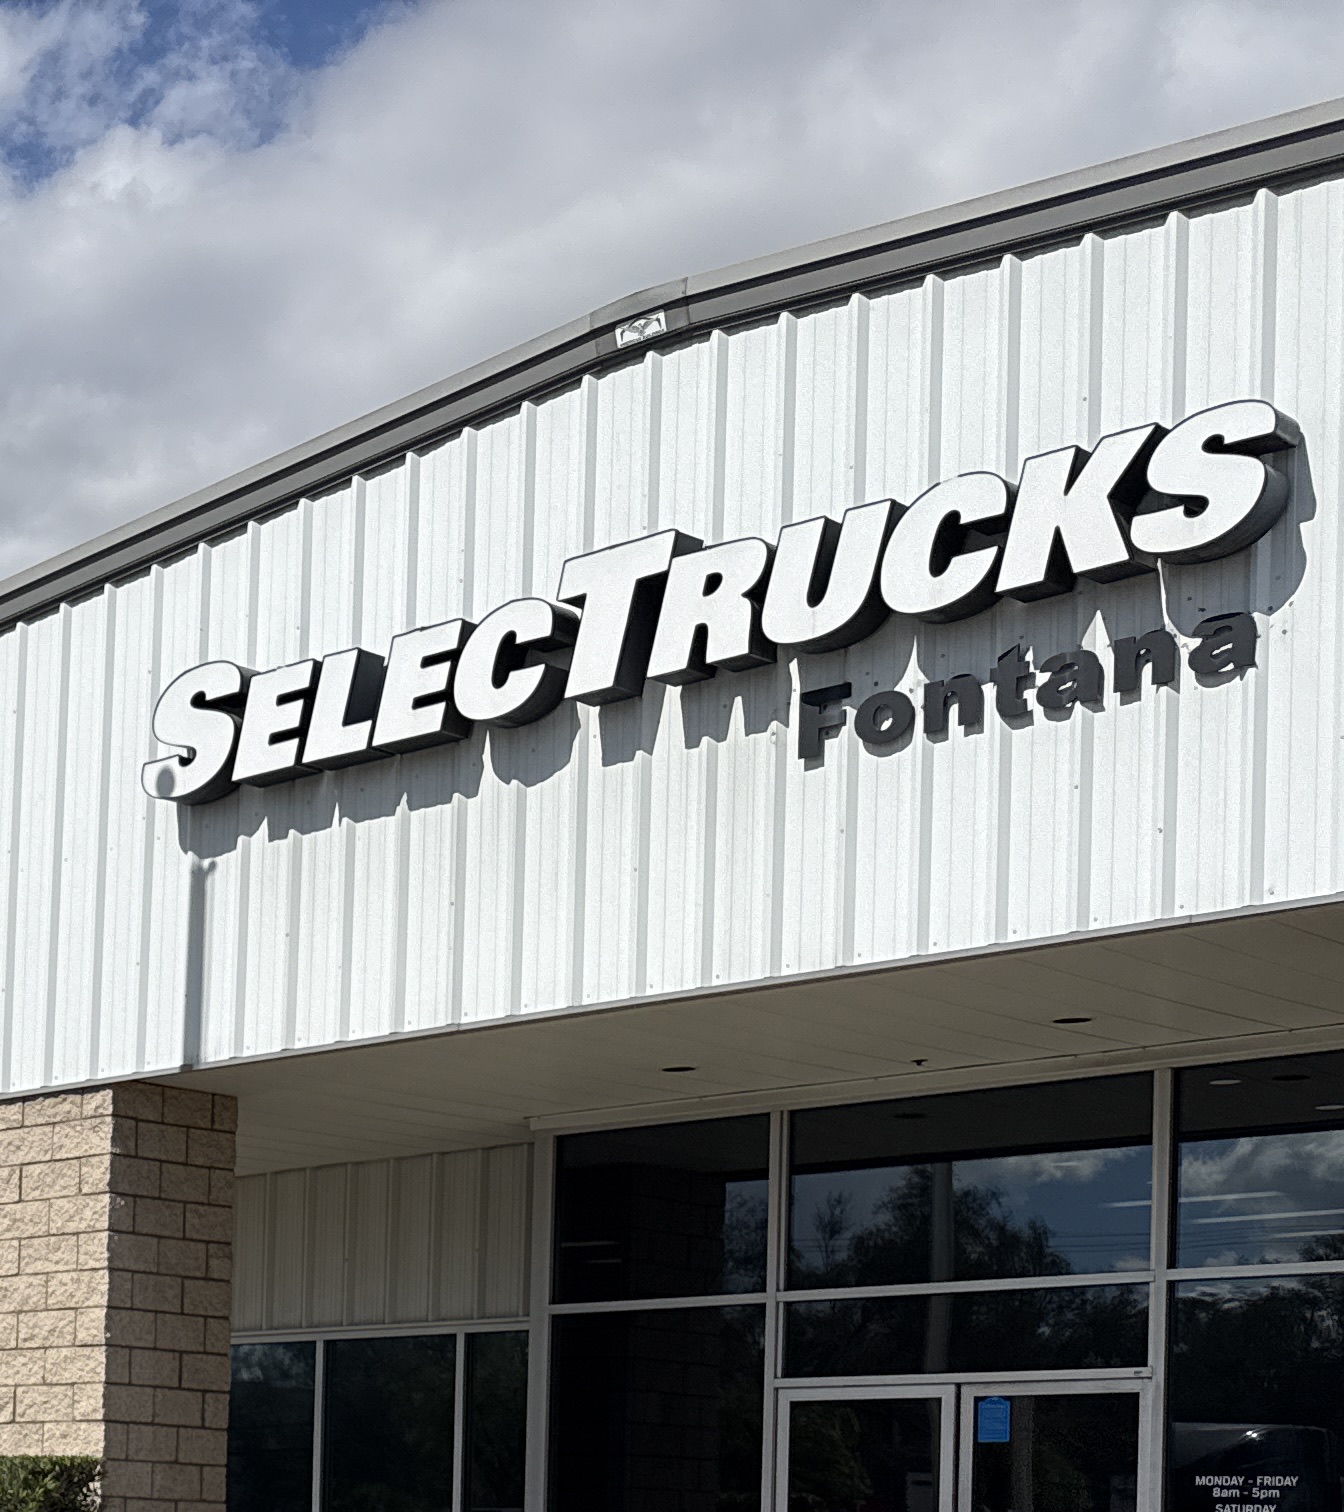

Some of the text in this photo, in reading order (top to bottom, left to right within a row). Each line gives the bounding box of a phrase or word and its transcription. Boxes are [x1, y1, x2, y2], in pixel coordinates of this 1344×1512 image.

[141, 399, 1297, 803] SELECTRUCKS
[796, 611, 1258, 760] Fontana
[1195, 1475, 1245, 1486] MONDAY
[1256, 1475, 1299, 1487] FRIDAY
[1212, 1487, 1240, 1498] 8am
[1252, 1487, 1280, 1500] 5pm
